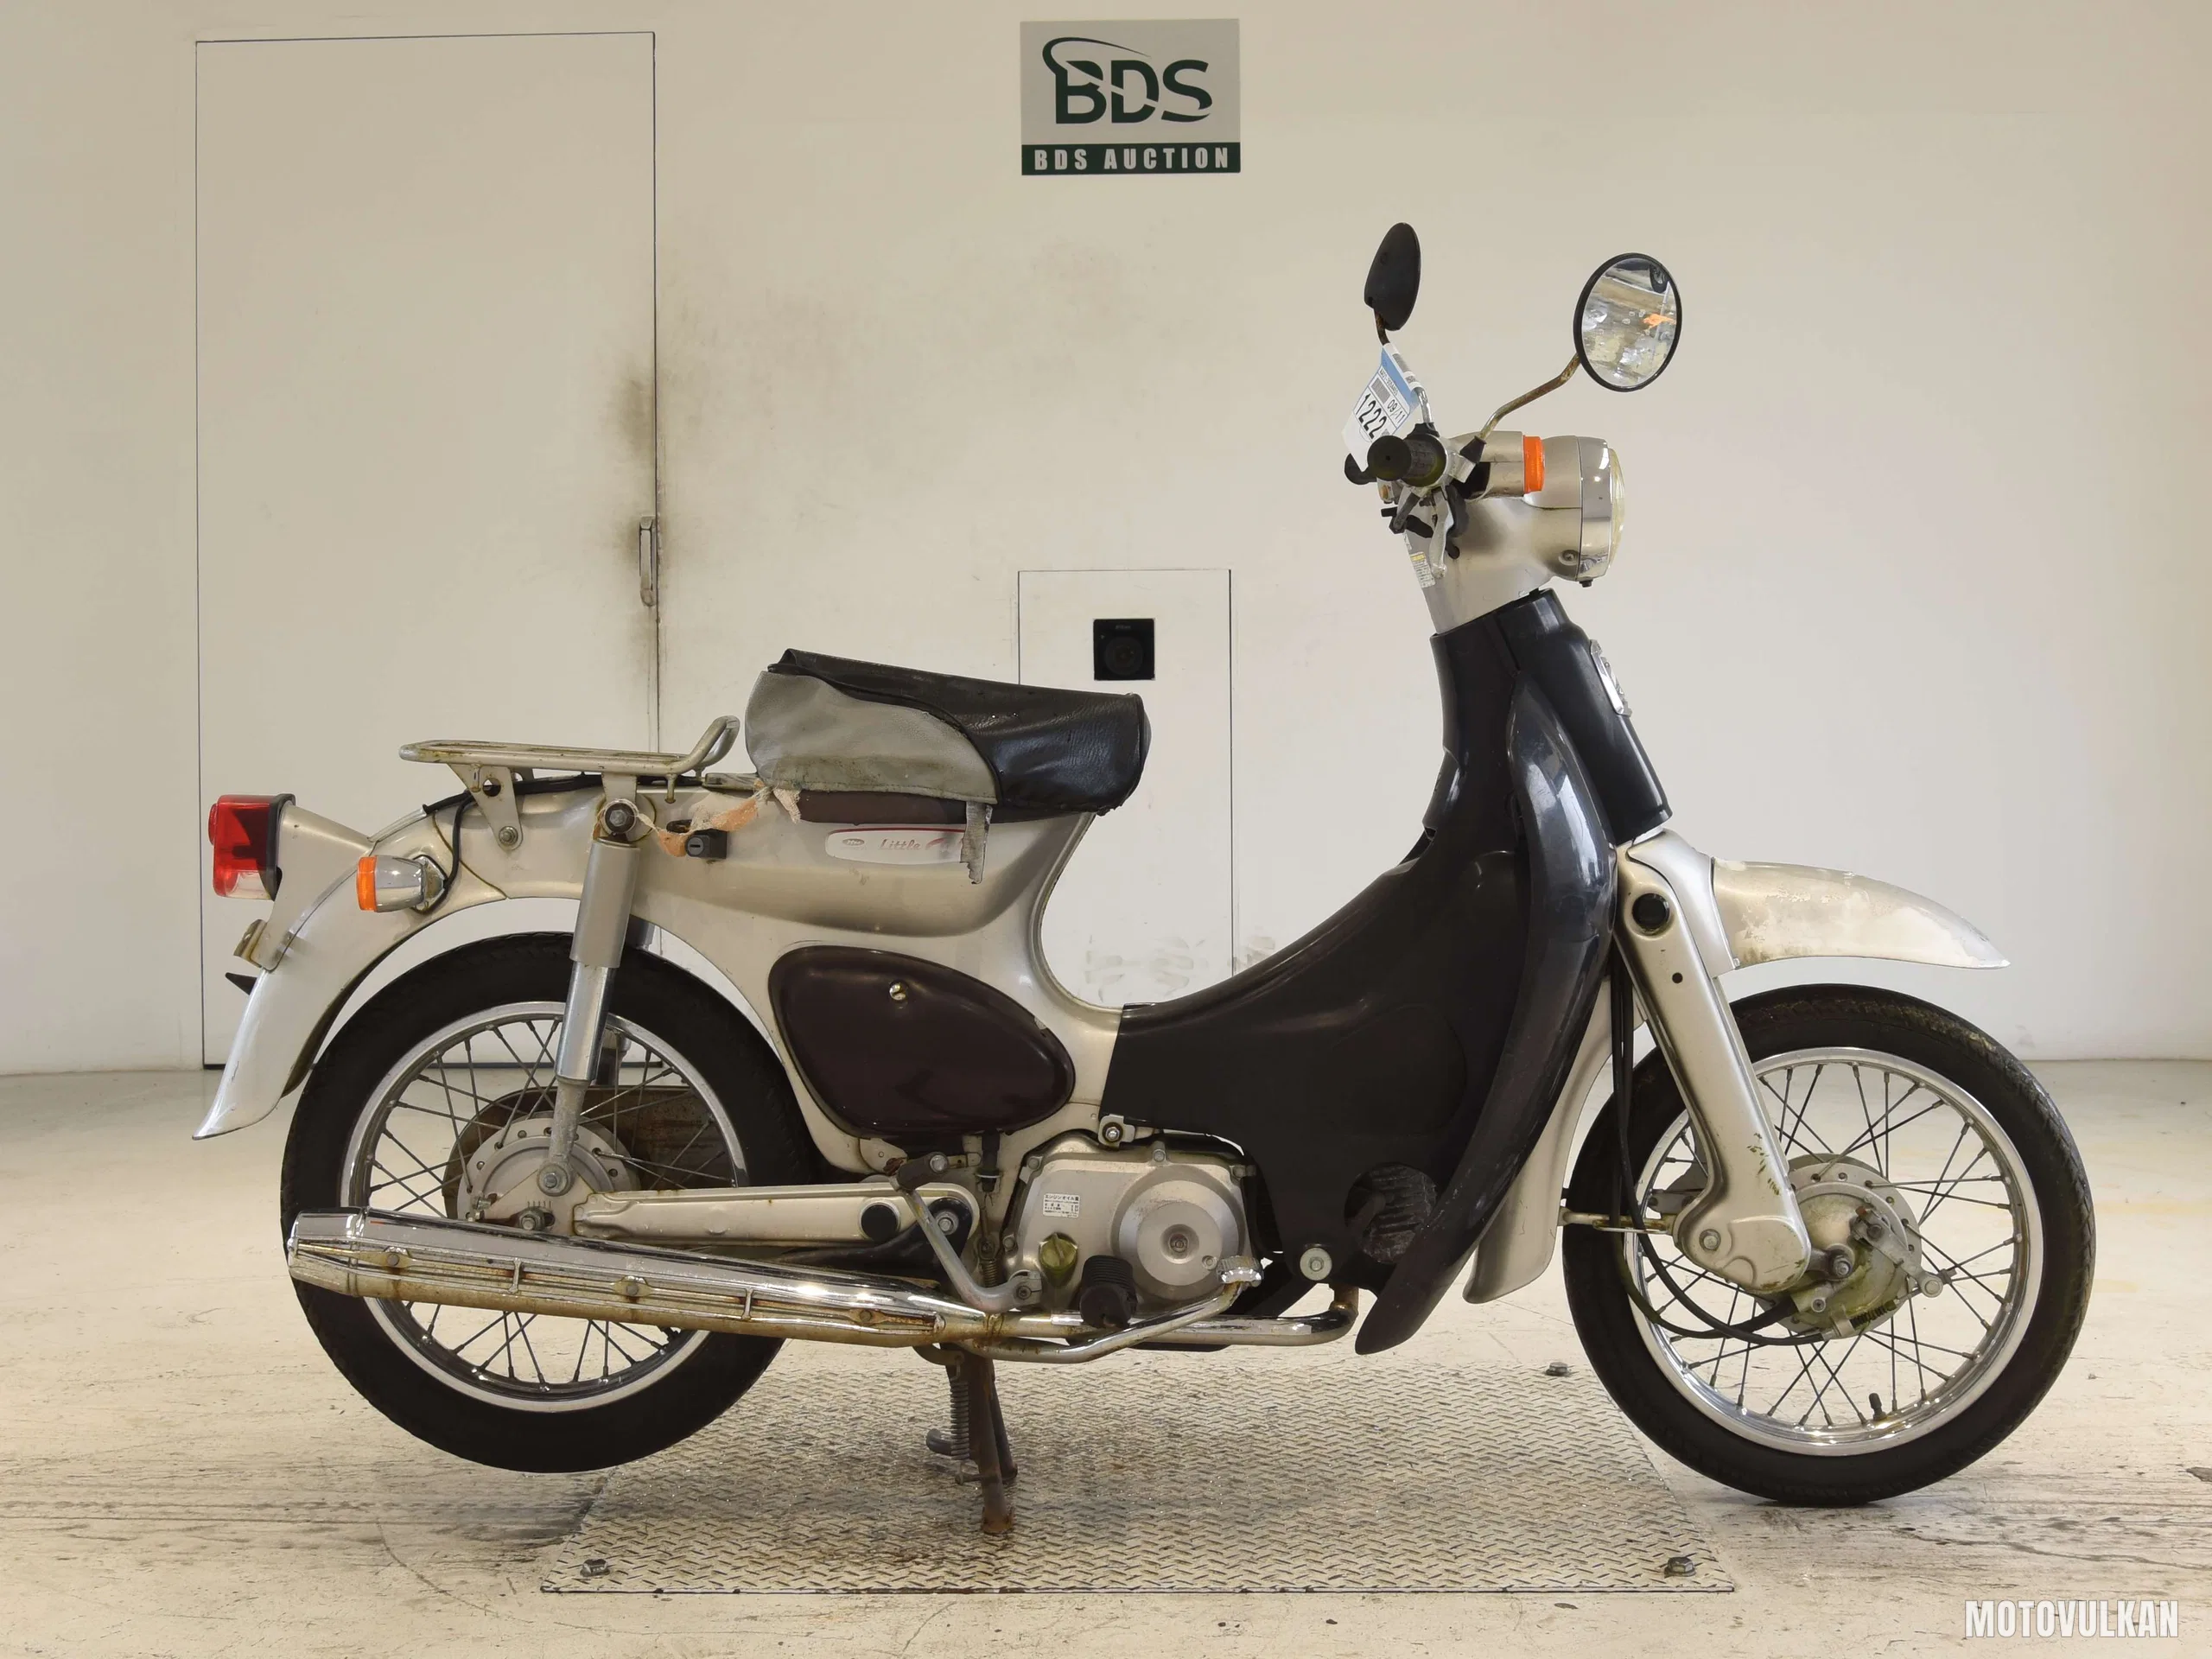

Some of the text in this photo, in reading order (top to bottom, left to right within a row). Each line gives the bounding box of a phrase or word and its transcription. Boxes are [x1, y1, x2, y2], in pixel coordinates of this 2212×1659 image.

[1042, 37, 1212, 124] BDS
[1034, 147, 1228, 170] BDS AUCTION
[1355, 393, 1388, 440] 1222
[879, 838, 921, 850] Little
